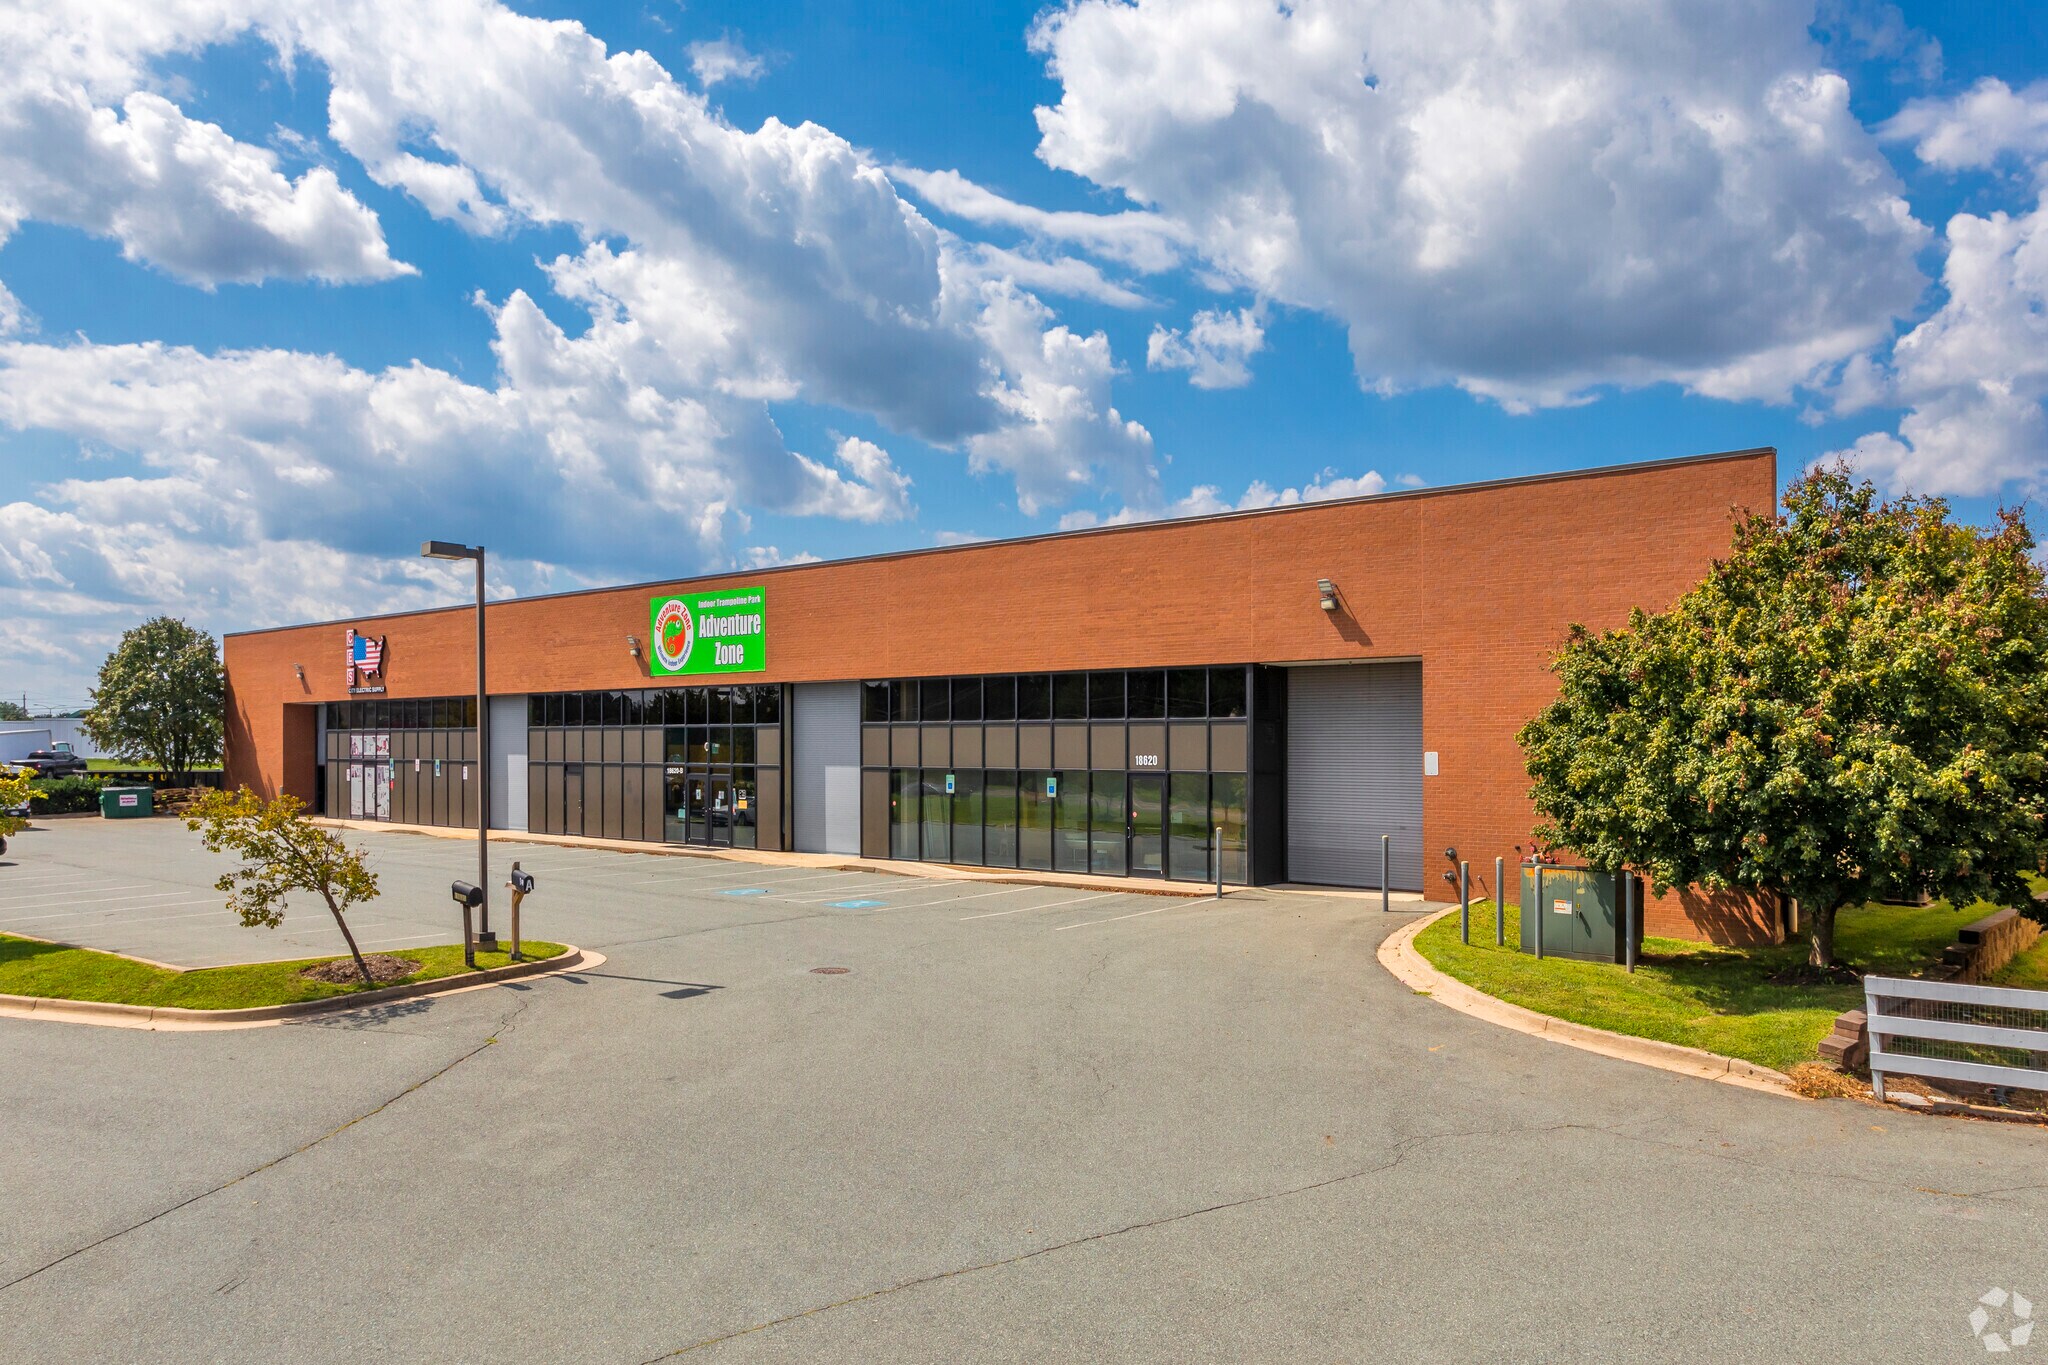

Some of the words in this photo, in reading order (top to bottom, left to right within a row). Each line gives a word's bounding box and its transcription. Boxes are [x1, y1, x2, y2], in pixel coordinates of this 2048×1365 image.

[698, 600, 716, 608] Indoor
[716, 597, 747, 606] Trampoline
[748, 595, 760, 604] Park
[656, 603, 681, 633] Adventure
[681, 607, 692, 631] Zone
[699, 613, 761, 638] Adventure
[714, 641, 744, 665] Zone
[1135, 755, 1158, 766] 18620
